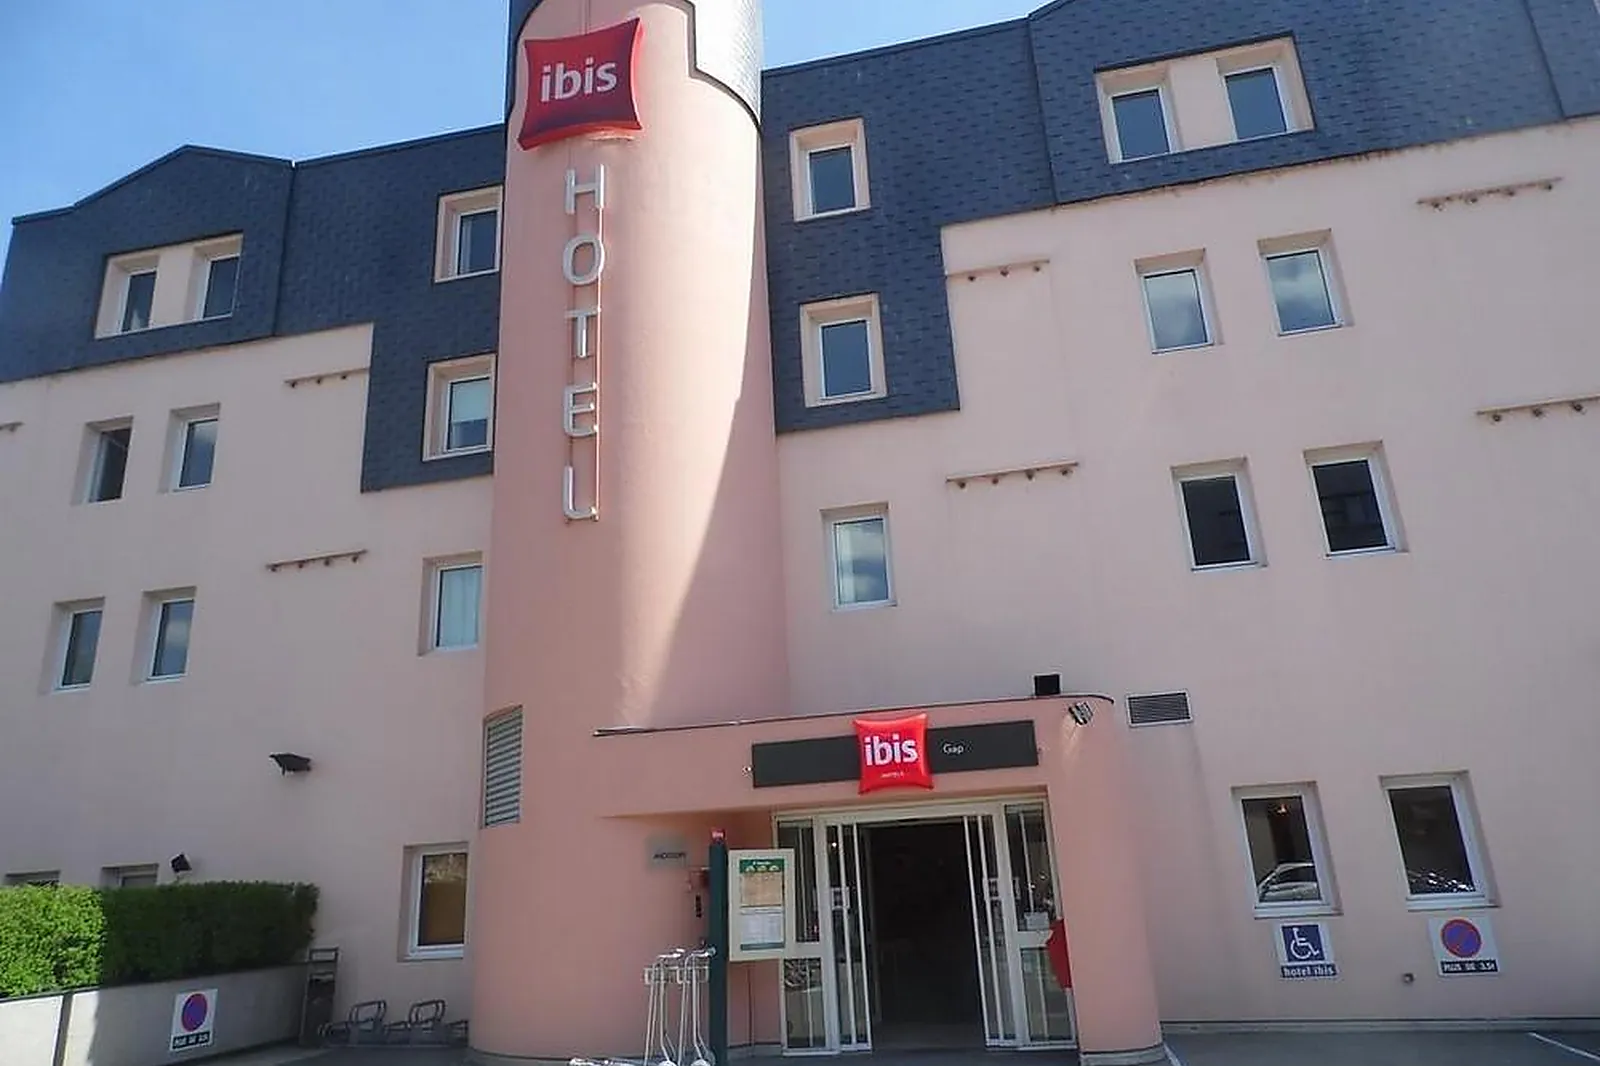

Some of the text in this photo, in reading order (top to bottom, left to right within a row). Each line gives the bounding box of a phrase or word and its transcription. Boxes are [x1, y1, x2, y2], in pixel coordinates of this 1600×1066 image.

[540, 56, 617, 103] ibis
[563, 163, 605, 519] HOTEL
[864, 733, 918, 766] ibis
[943, 743, 964, 754] Gap
